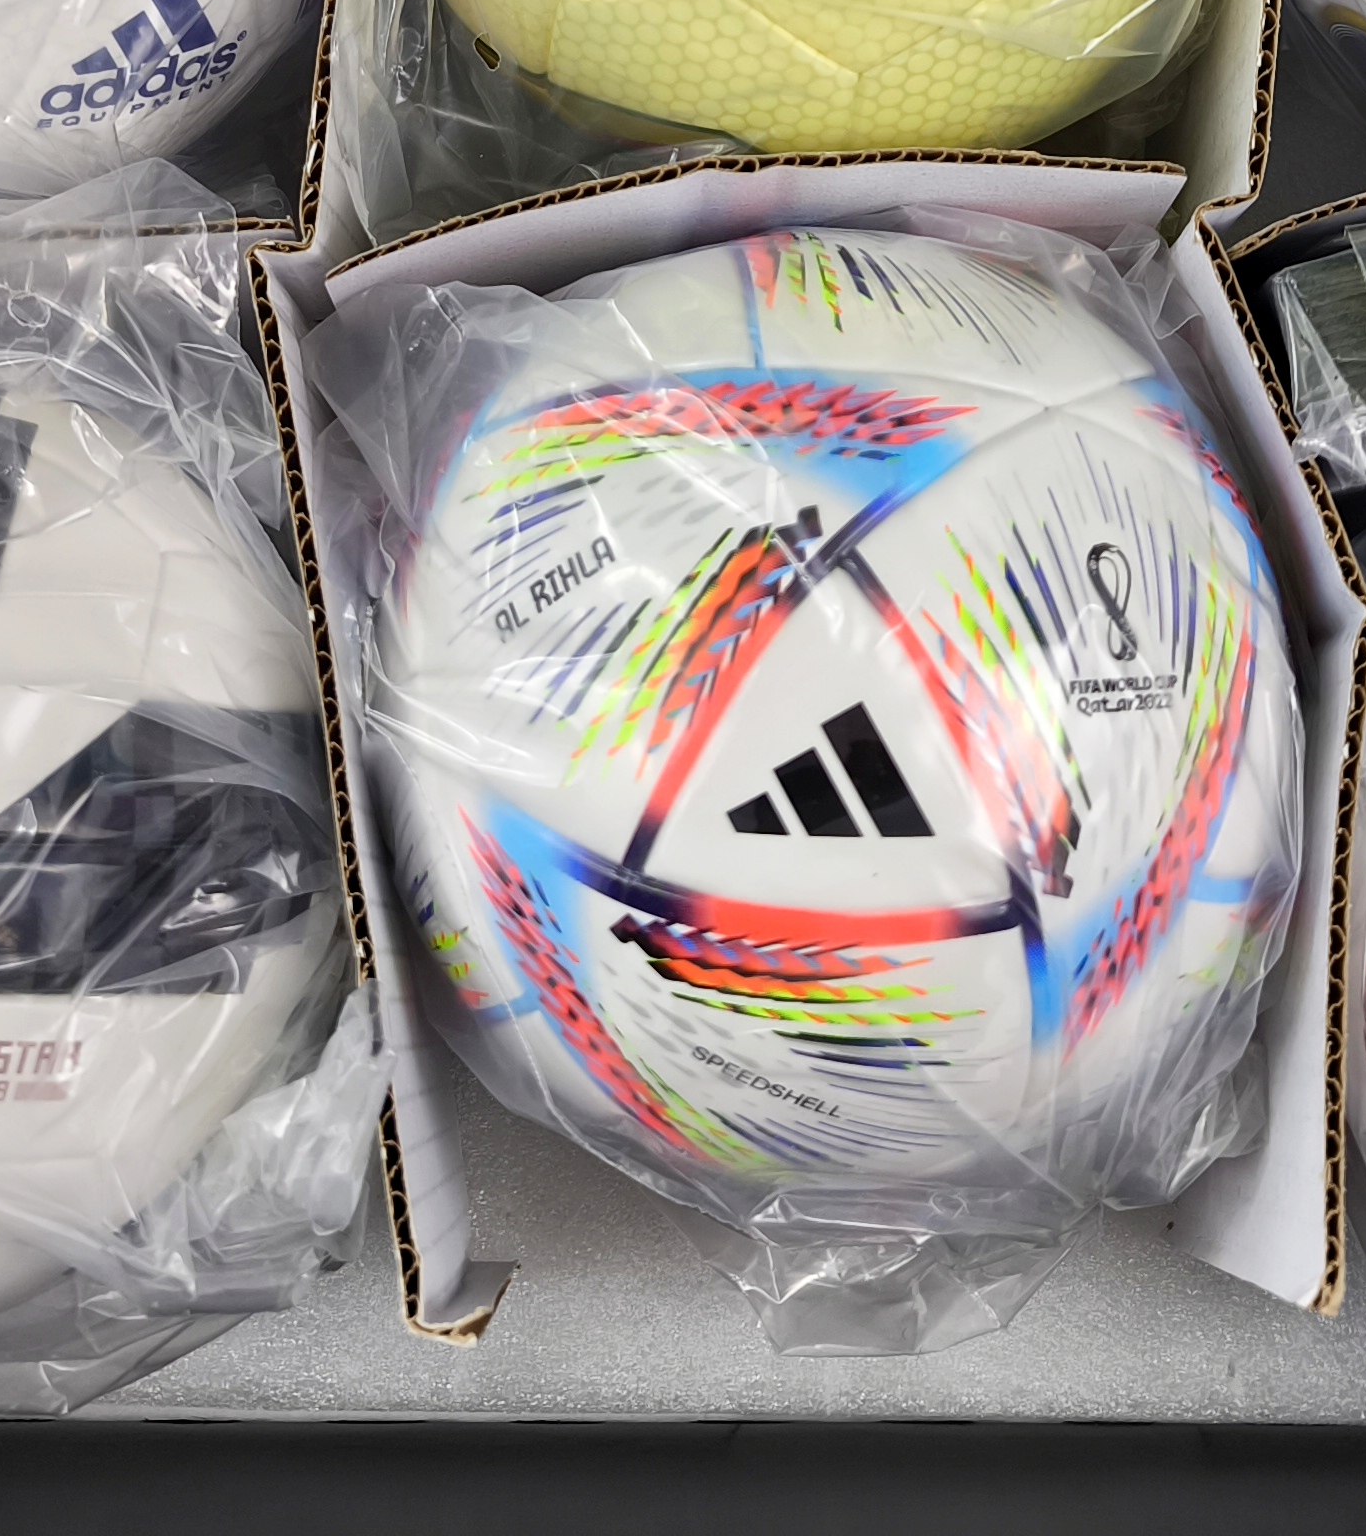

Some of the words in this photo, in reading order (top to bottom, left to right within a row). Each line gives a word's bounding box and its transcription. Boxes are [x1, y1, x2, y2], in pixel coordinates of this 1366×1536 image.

[37, 71, 230, 128] EQUPMENT
[40, 42, 238, 115] adidas
[530, 536, 615, 613] RIHLA
[1070, 679, 1102, 694] FIFA
[692, 1046, 840, 1117] SPEEDSHELL
